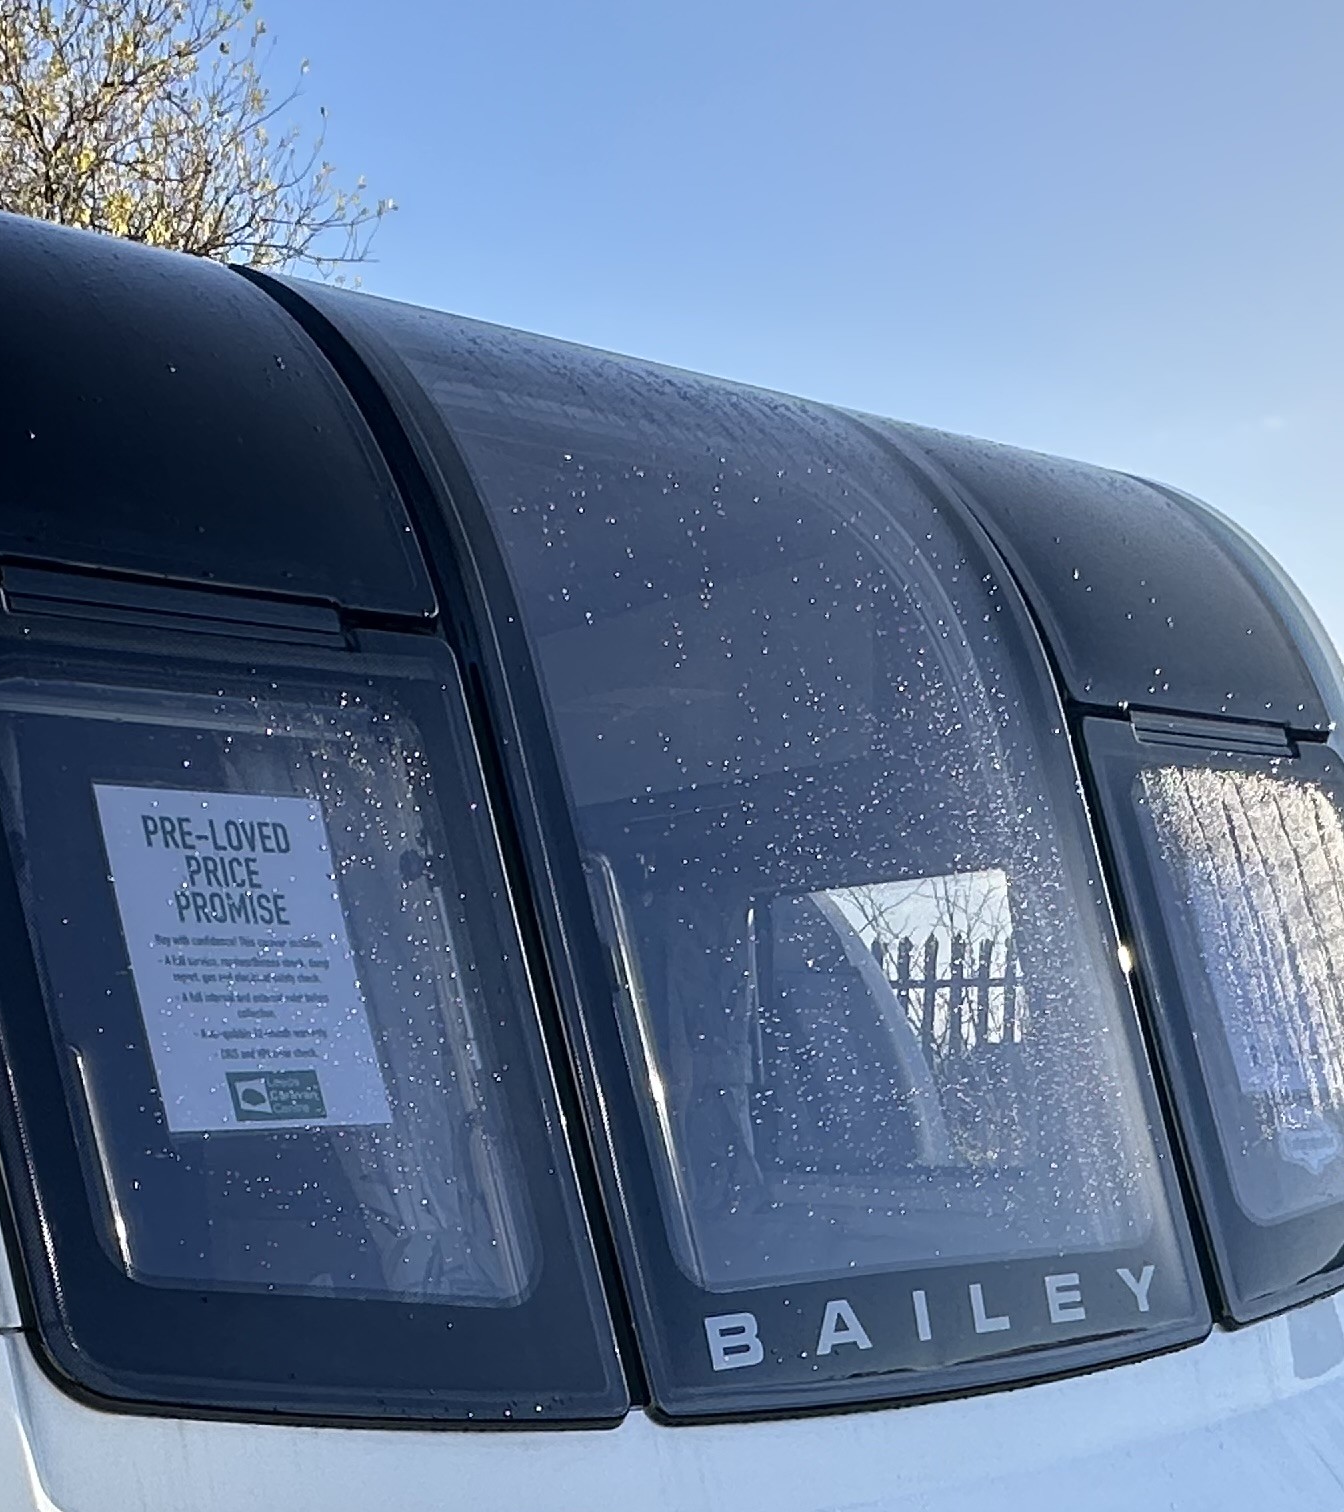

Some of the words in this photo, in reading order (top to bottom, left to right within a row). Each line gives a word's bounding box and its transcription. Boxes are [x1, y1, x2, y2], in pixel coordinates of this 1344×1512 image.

[141, 814, 291, 853] PRE-LOVED
[185, 854, 262, 889] PRICE
[174, 890, 291, 925] PROMISE
[703, 1264, 1156, 1372] BAILEY
